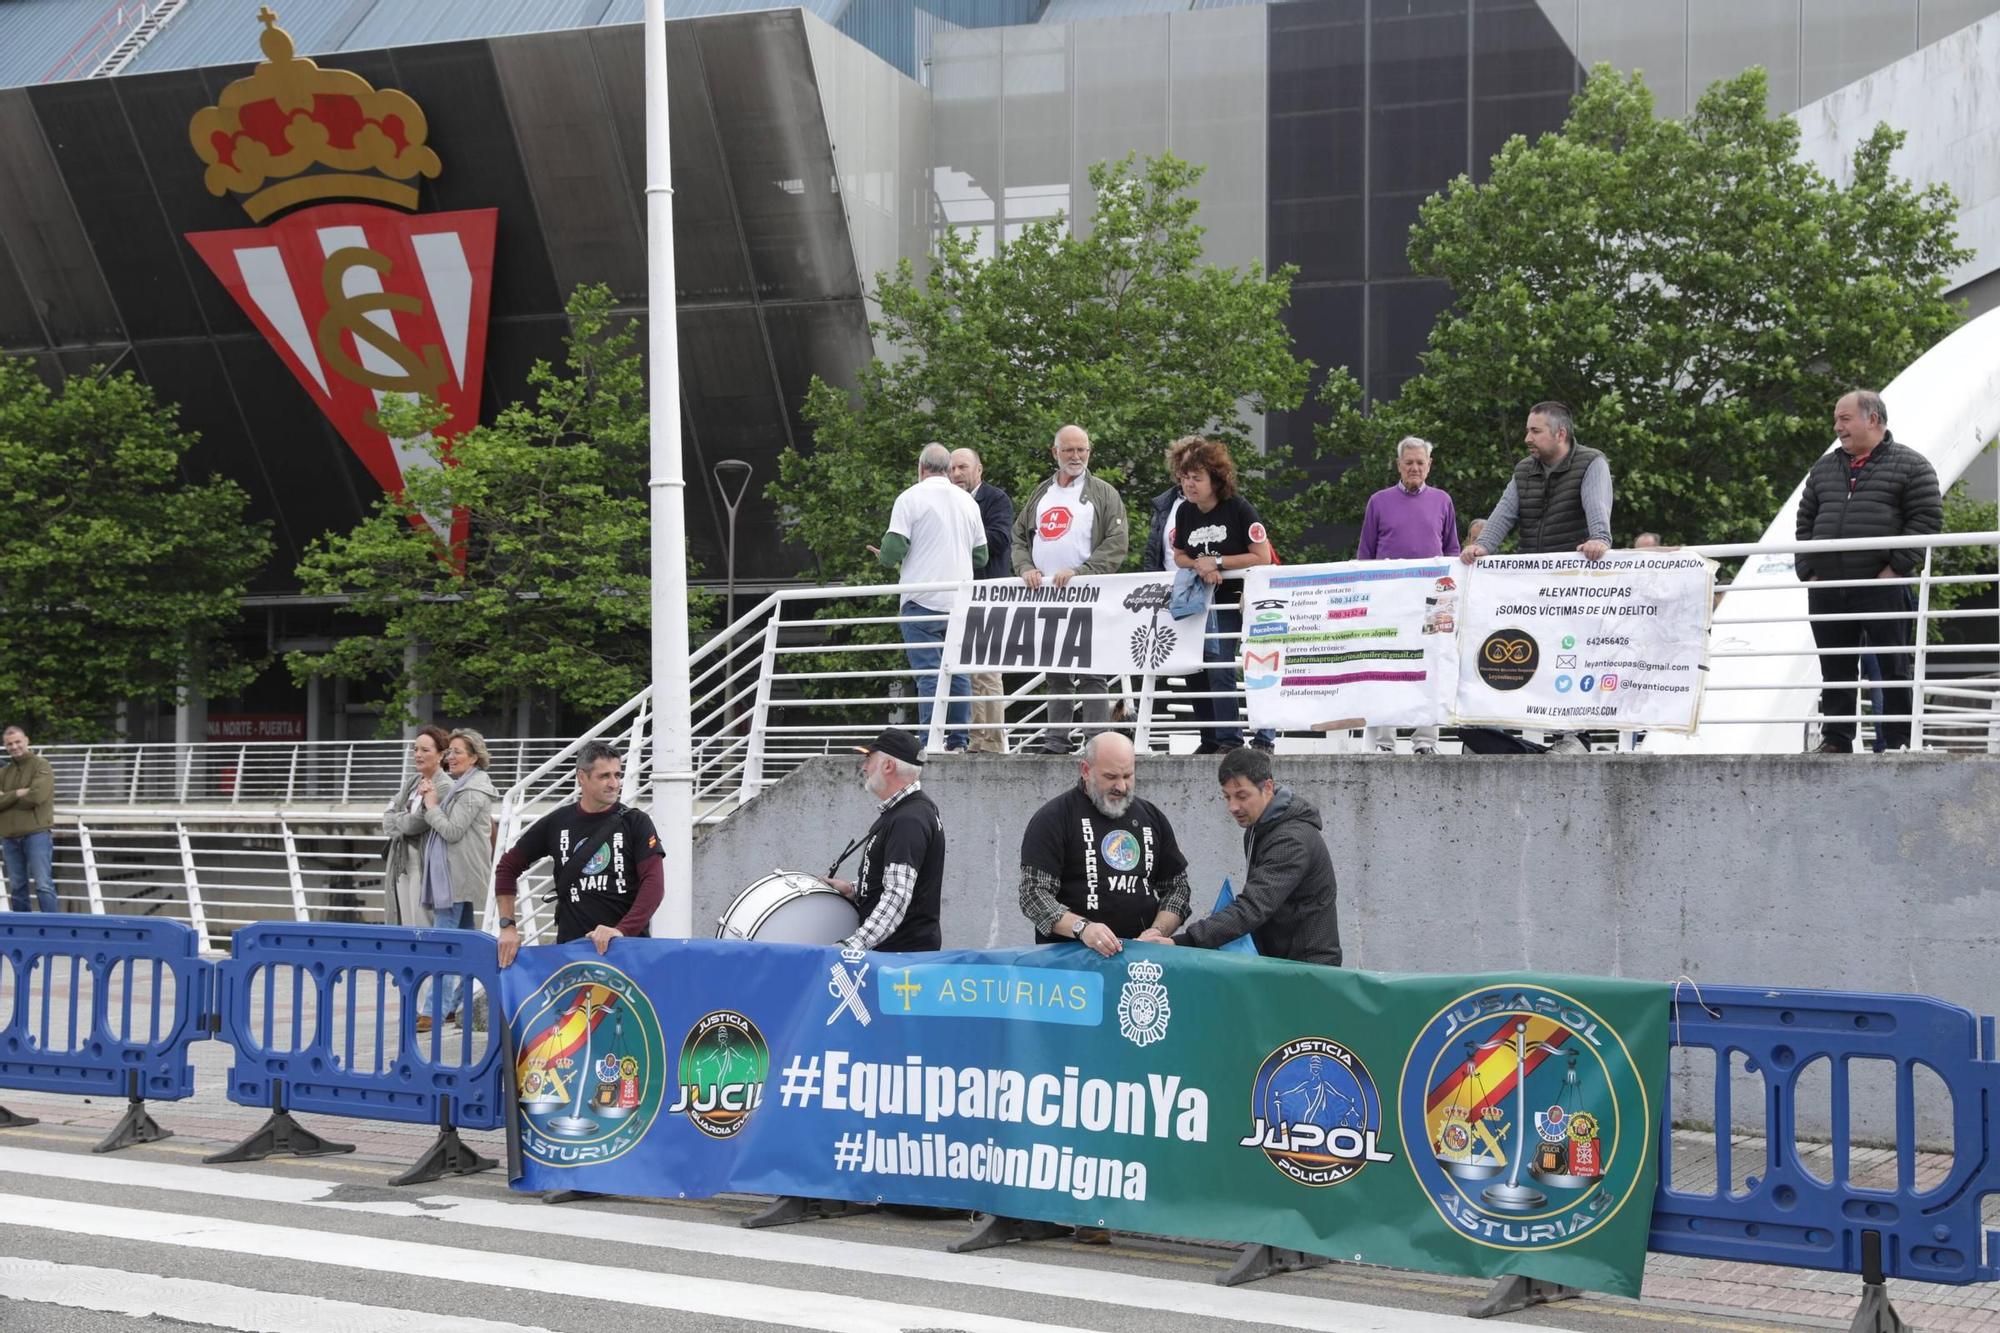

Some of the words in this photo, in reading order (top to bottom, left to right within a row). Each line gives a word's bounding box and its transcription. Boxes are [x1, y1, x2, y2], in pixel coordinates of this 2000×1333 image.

[1476, 559, 1540, 570] PLATAFORMA
[1542, 559, 1553, 570] DE
[1555, 559, 1612, 570] AFECTADOS
[1613, 560, 1633, 569] POR
[1634, 560, 1645, 569] LA
[971, 585, 987, 602] LA
[990, 583, 1100, 603] CONTAMINACIÓN
[1538, 586, 1632, 598] #LEYANTIOCUPAS
[1495, 604, 1537, 616] ¡SOMOS
[1586, 605, 1600, 615] DE
[1602, 605, 1617, 615] UN
[1619, 605, 1658, 616] DELITO!
[959, 606, 1093, 669] MATA
[1586, 636, 1630, 646] 642456426
[1584, 659, 1690, 672] leyantiocupas@gmail.com
[1620, 679, 1690, 693] @leyantiocupas
[222, 721, 252, 736] NORTE
[259, 721, 294, 736] PUERTA
[294, 721, 301, 735] 4
[1081, 818, 1099, 910] EQUIPARACION
[579, 874, 608, 892] YA!!
[1107, 874, 1139, 894] YA!!
[938, 978, 1087, 1010] ASTURIAS
[699, 1013, 749, 1034] JUSTICIA
[1445, 992, 1602, 1046] JUSAPOL
[1282, 1040, 1352, 1067] JUSTICIA
[779, 1050, 1209, 1143] #EquiparacionYa
[691, 1109, 732, 1135] GUARDIA
[1239, 1118, 1394, 1162] JUPOL
[833, 1129, 1147, 1202] #JubilacionDigna
[1278, 1158, 1353, 1183] POLICIAL
[1440, 1187, 1615, 1242] ASTURIAS
